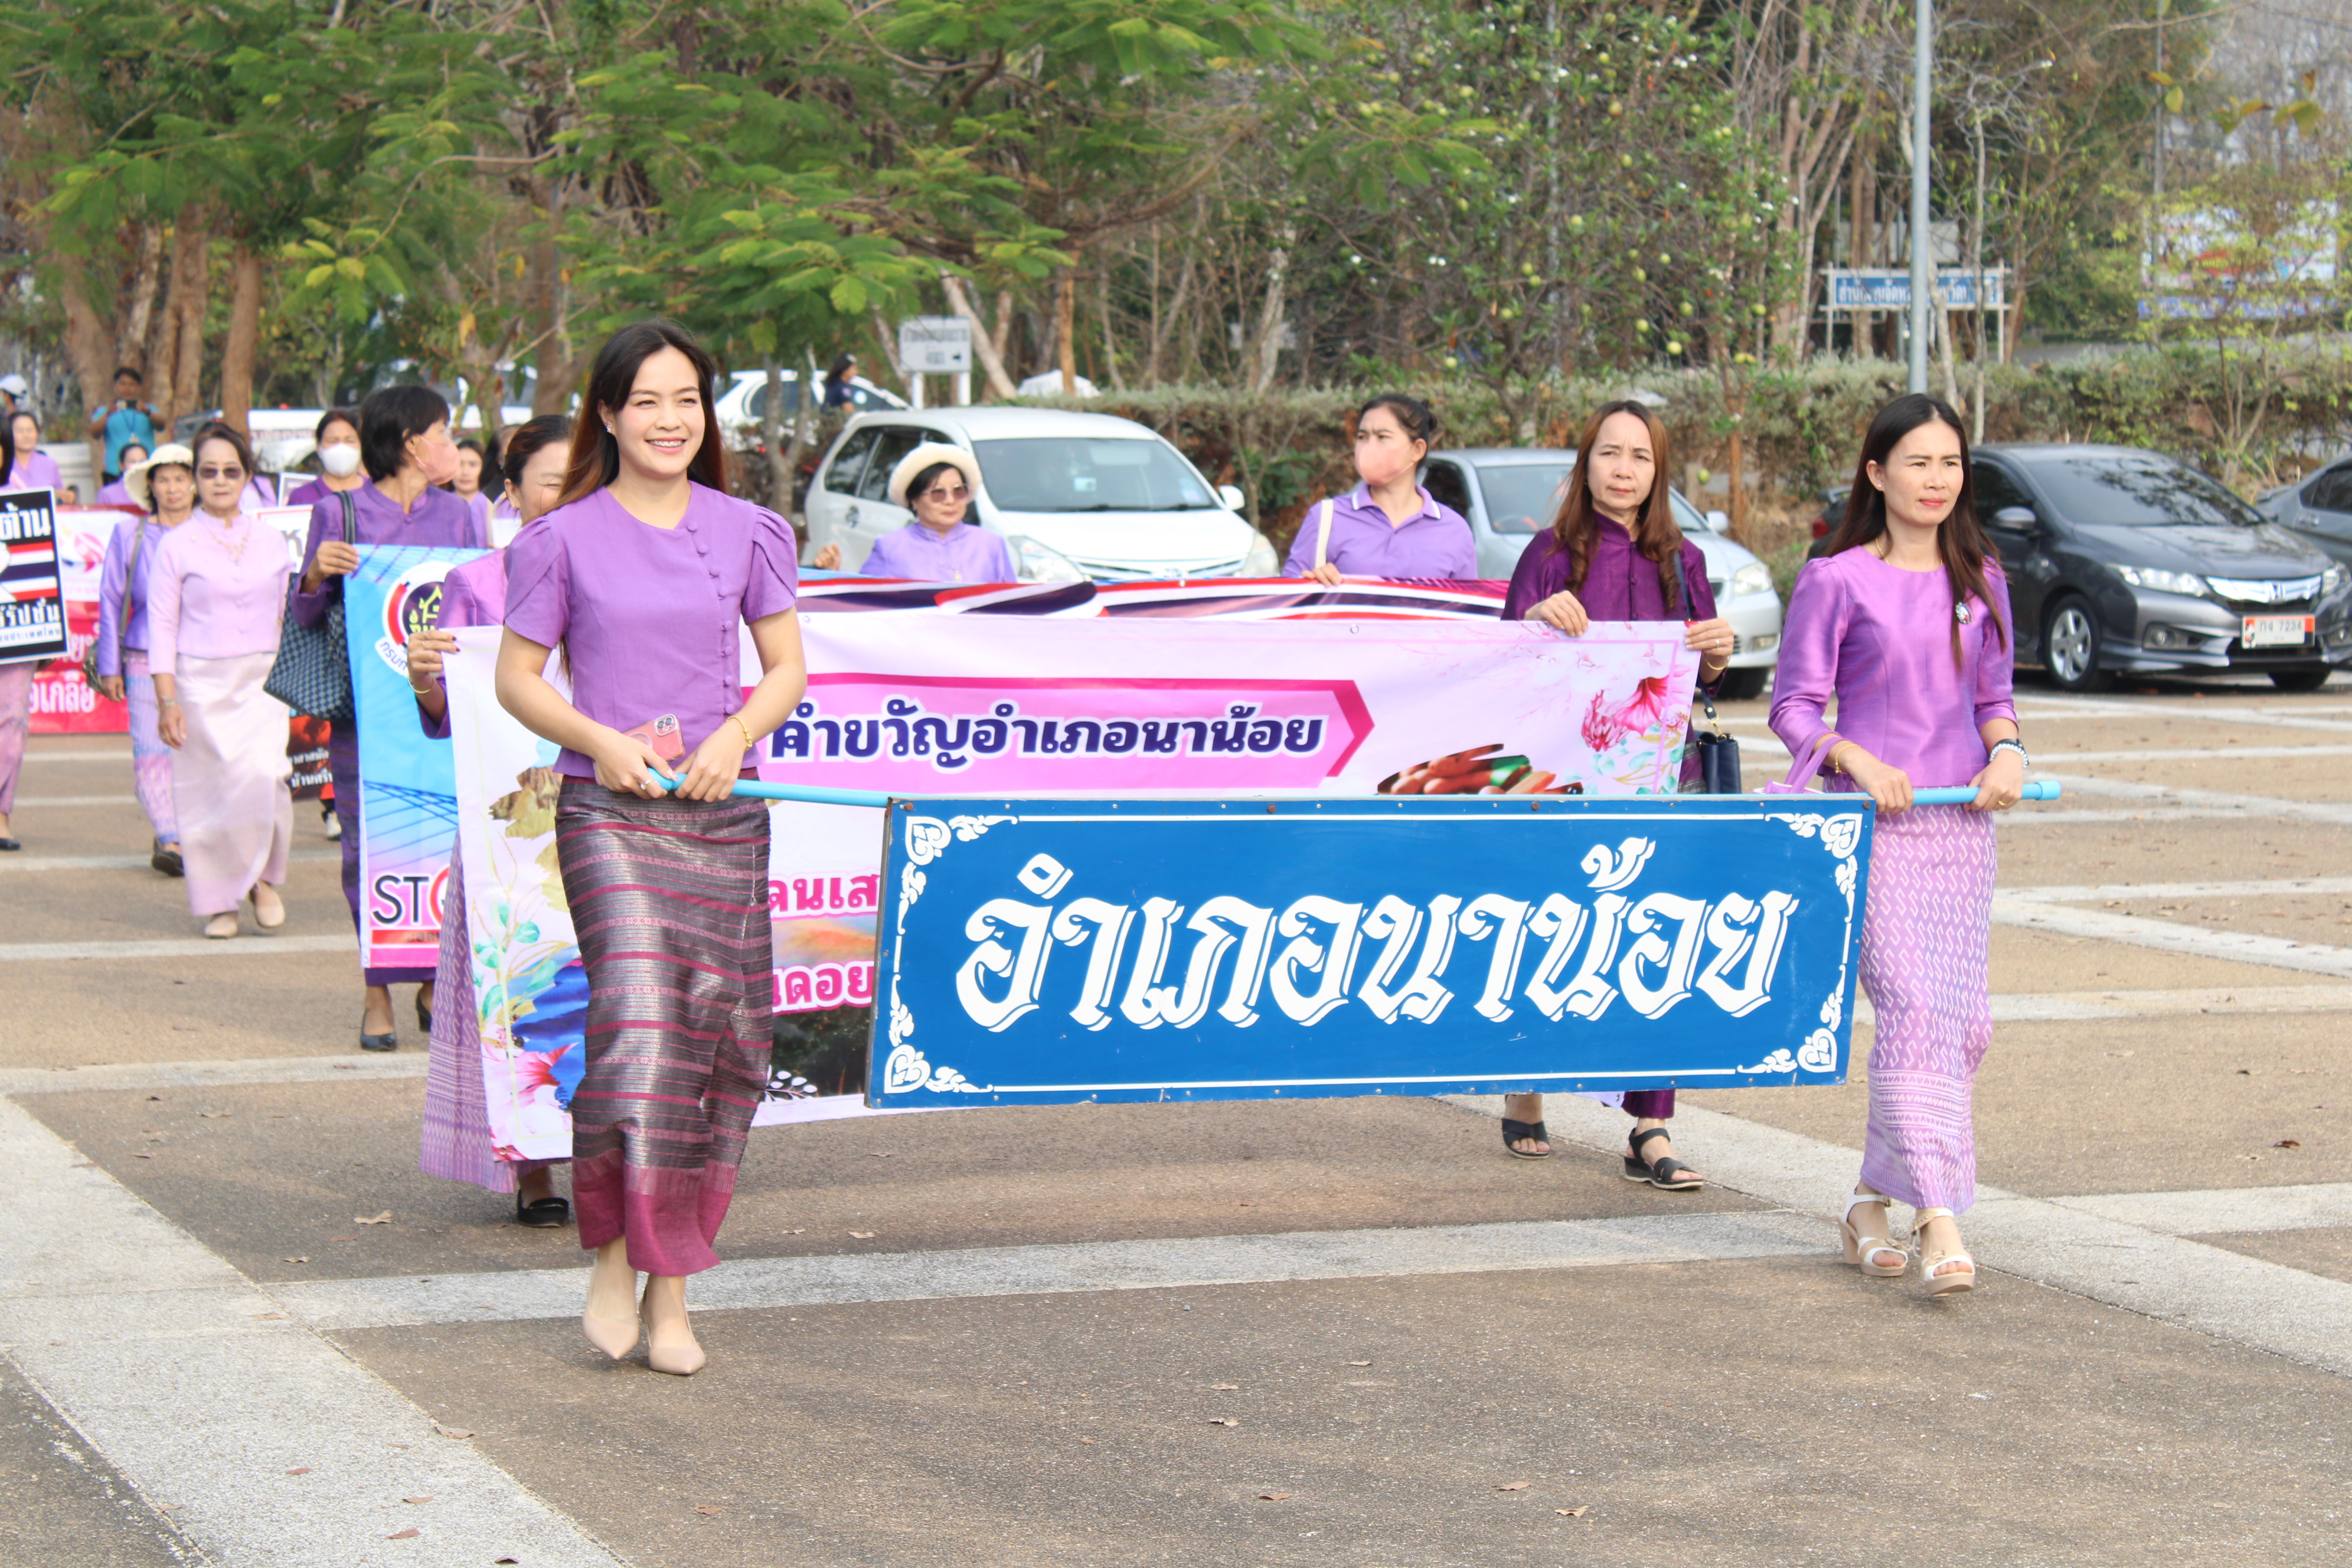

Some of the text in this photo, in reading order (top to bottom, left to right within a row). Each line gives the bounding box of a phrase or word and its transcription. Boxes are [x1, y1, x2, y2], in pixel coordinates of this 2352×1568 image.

[2279, 620, 2302, 632] 7234
[771, 698, 1323, 768] คำขวัญอำเภอนาน้อย
[956, 836, 1799, 1032] อำเภอนาน้อย
